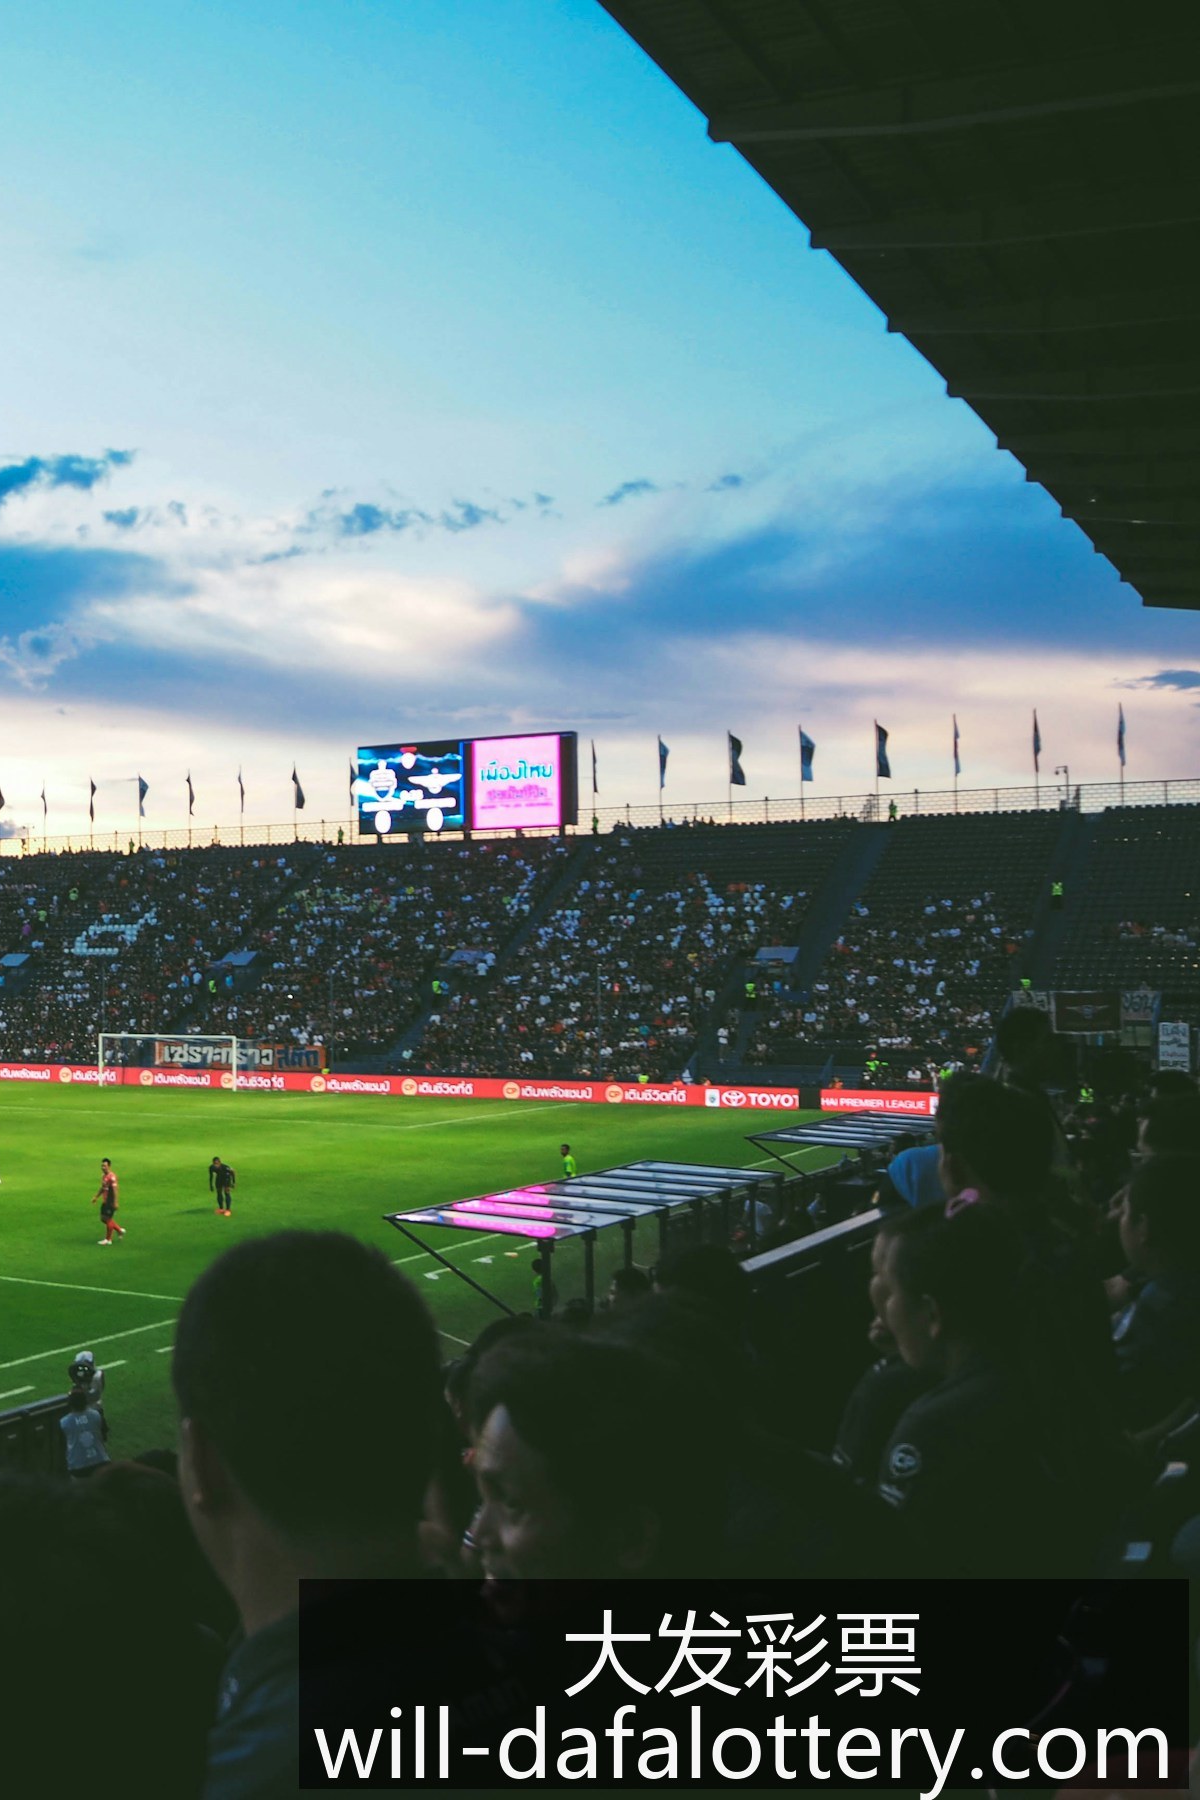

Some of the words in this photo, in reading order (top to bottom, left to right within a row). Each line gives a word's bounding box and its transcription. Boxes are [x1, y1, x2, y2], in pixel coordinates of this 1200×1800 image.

[821, 1097, 839, 1107] HAI
[839, 1098, 884, 1108] PREMIER
[886, 1099, 926, 1110] LEAGUE
